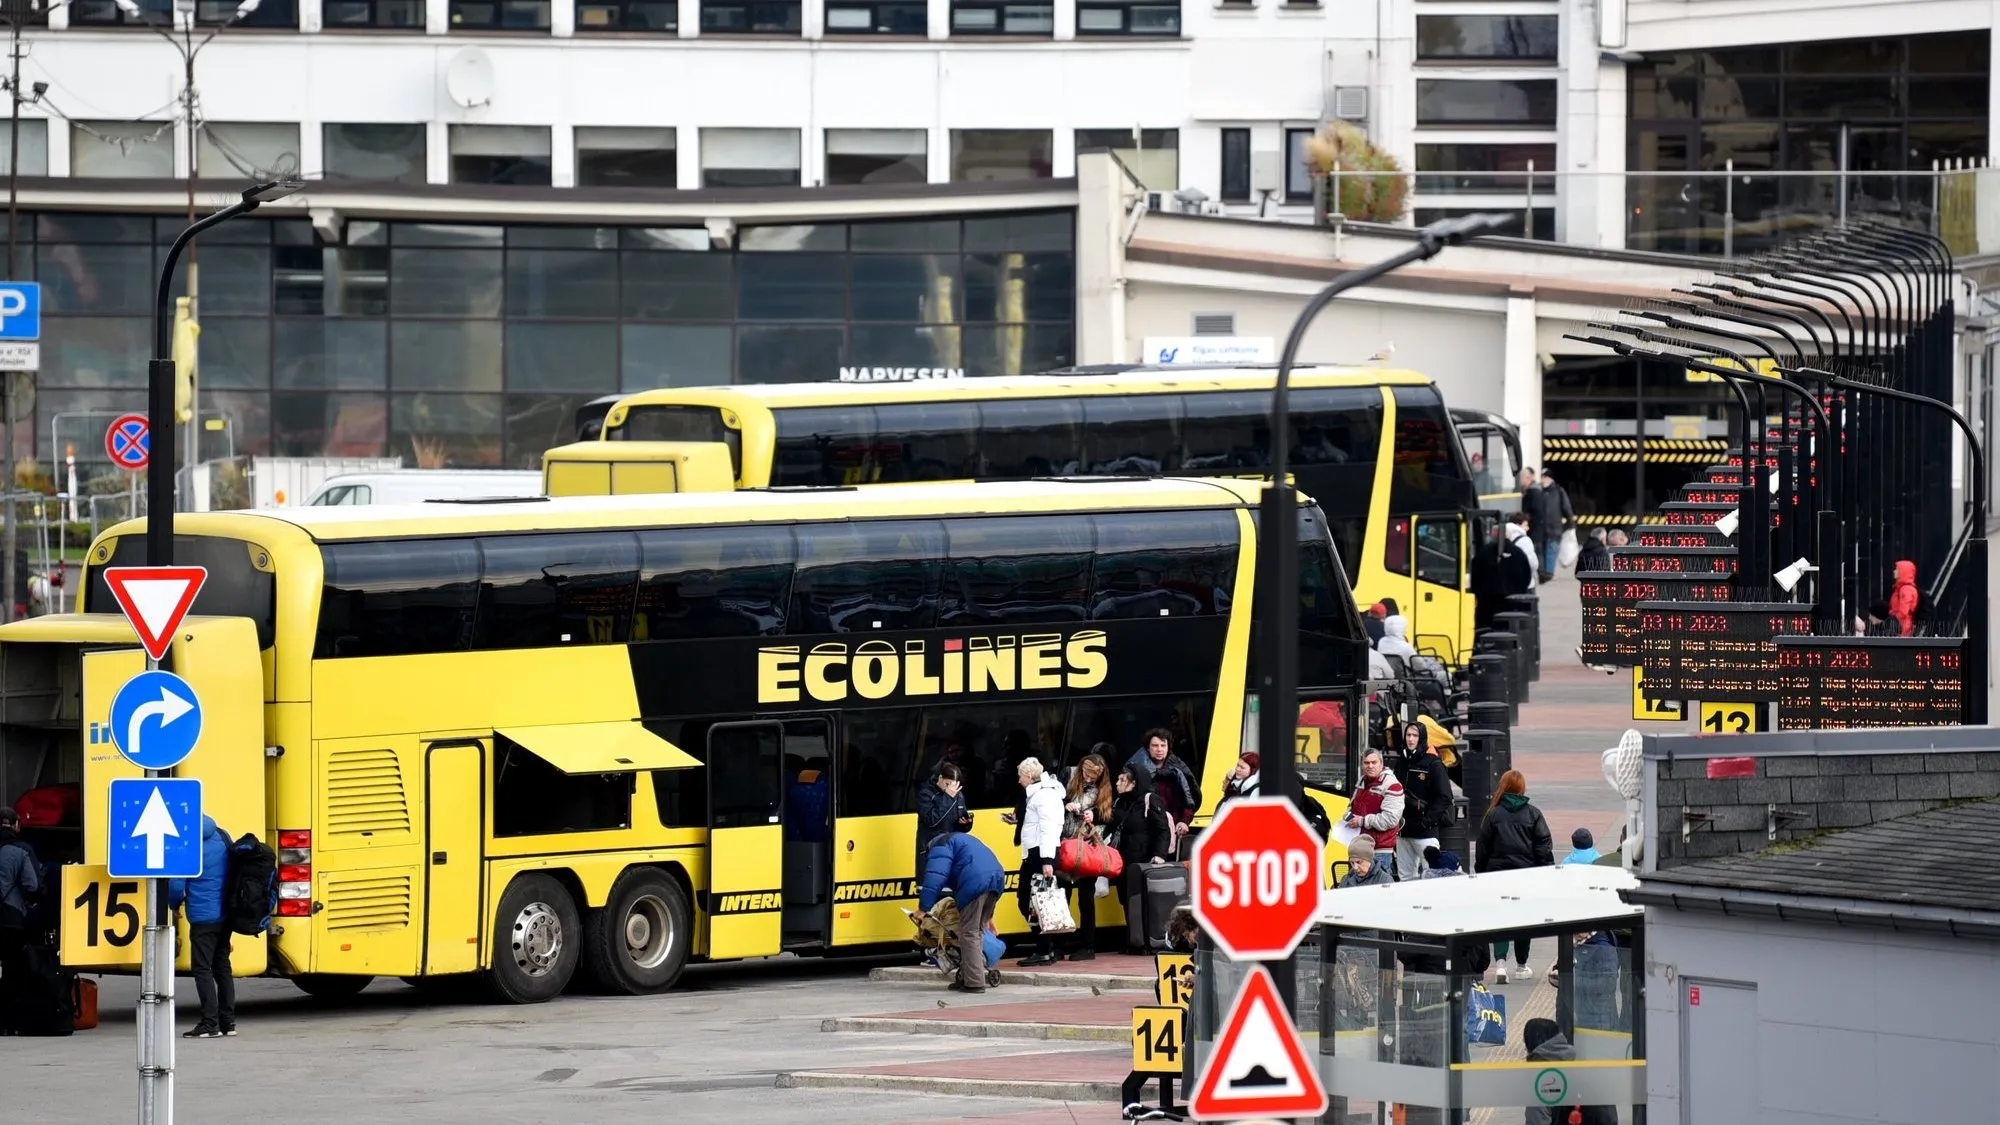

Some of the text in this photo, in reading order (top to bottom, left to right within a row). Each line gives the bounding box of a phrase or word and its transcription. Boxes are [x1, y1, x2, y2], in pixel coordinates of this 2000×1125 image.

[0, 289, 26, 332] P
[1206, 848, 1309, 908] STOP
[74, 881, 140, 948] 15
[1136, 1018, 1178, 1062] 14
